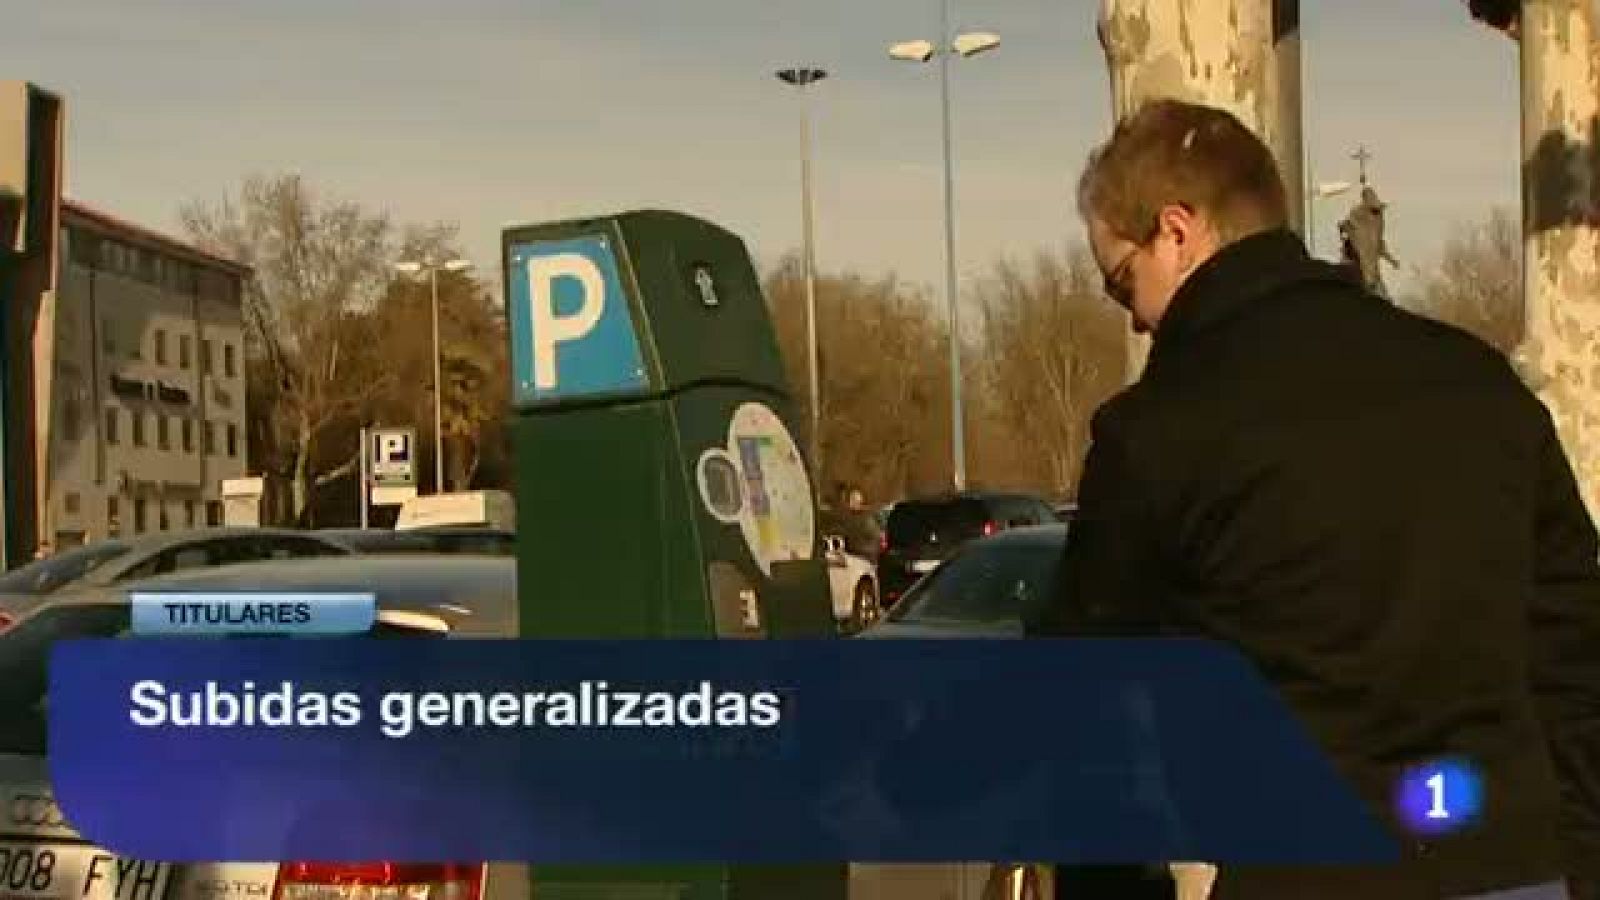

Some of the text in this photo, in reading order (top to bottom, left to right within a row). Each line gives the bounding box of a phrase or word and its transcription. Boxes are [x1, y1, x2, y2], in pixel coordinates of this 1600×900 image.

[527, 254, 604, 390] P
[381, 434, 403, 462] P
[82, 854, 160, 900] FYH
